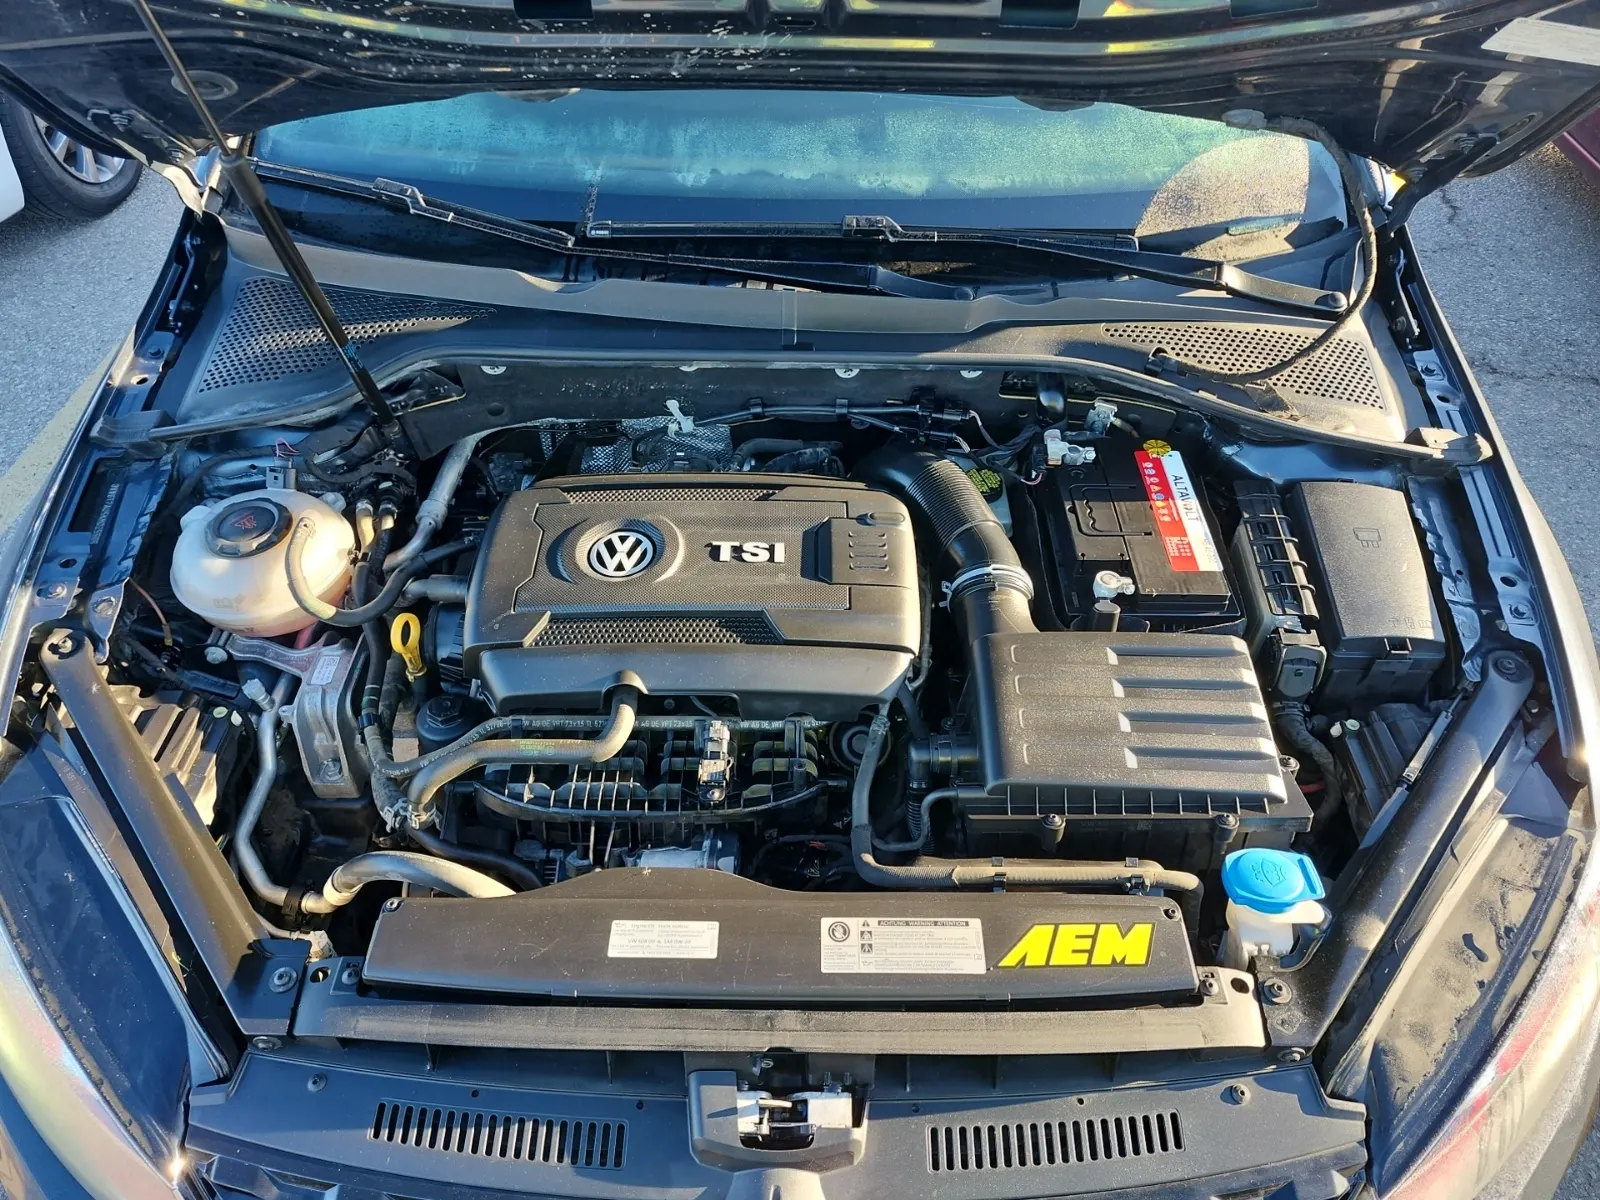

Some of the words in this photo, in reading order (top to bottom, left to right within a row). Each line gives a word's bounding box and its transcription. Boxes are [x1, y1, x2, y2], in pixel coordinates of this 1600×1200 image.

[1171, 474, 1199, 522] ALTAVOLT
[711, 541, 786, 563] TSI
[998, 923, 1153, 967] AEM
